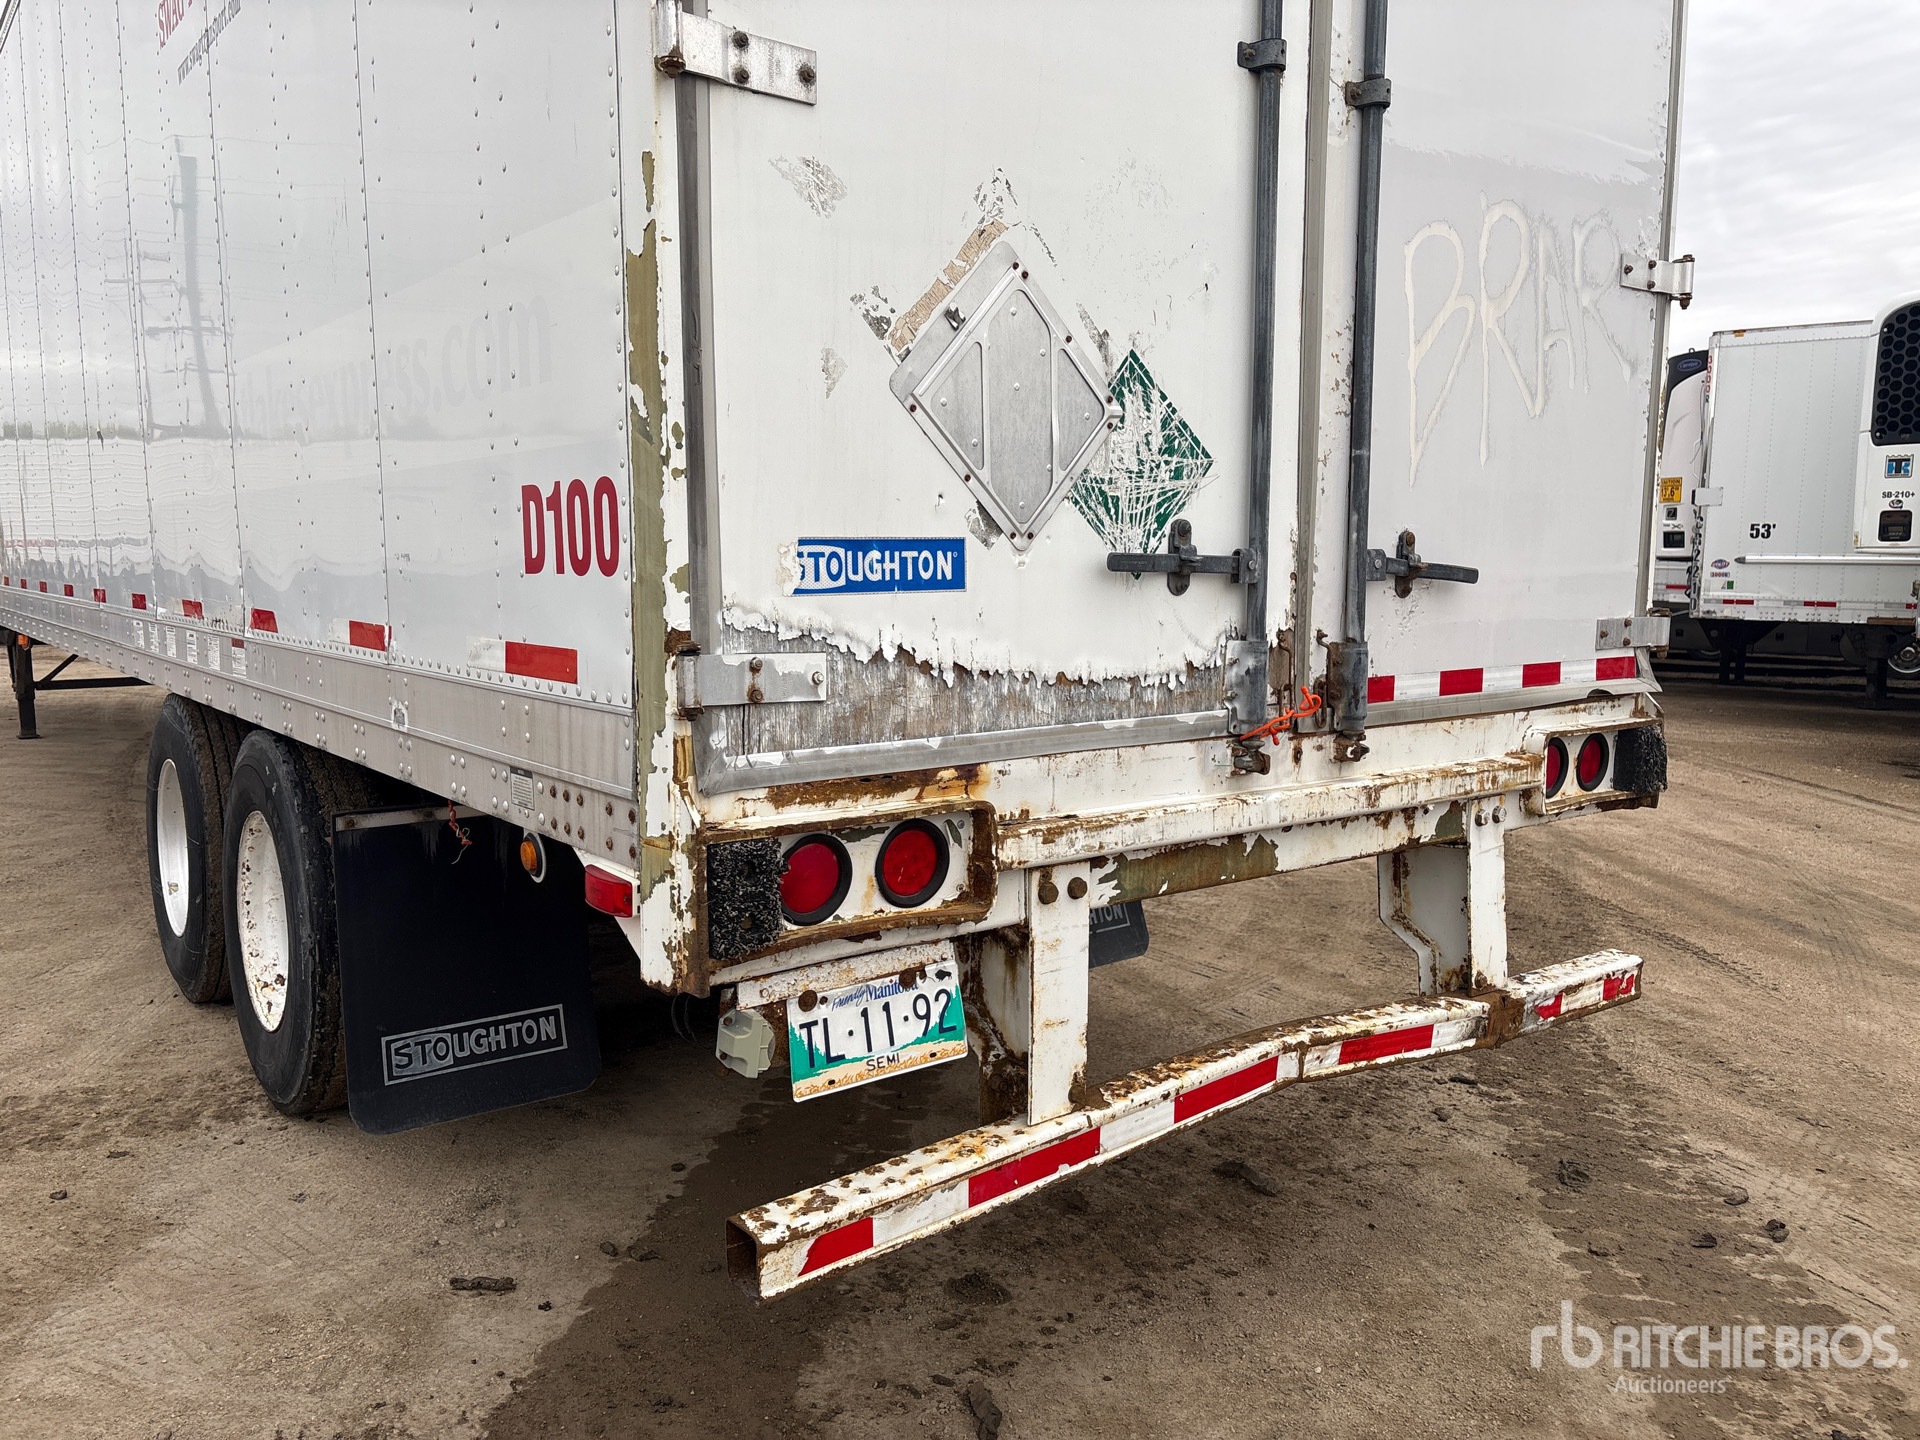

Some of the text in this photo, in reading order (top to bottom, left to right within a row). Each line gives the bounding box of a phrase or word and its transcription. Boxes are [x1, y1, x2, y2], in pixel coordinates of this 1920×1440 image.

[1881, 490, 1916, 499] SB-210+
[521, 475, 620, 577] D100
[1749, 522, 1777, 540] 53'
[831, 976, 919, 1012] Friendly Manitoa
[393, 1015, 558, 1070] STOUGHTON
[866, 1052, 900, 1072] SEMI
